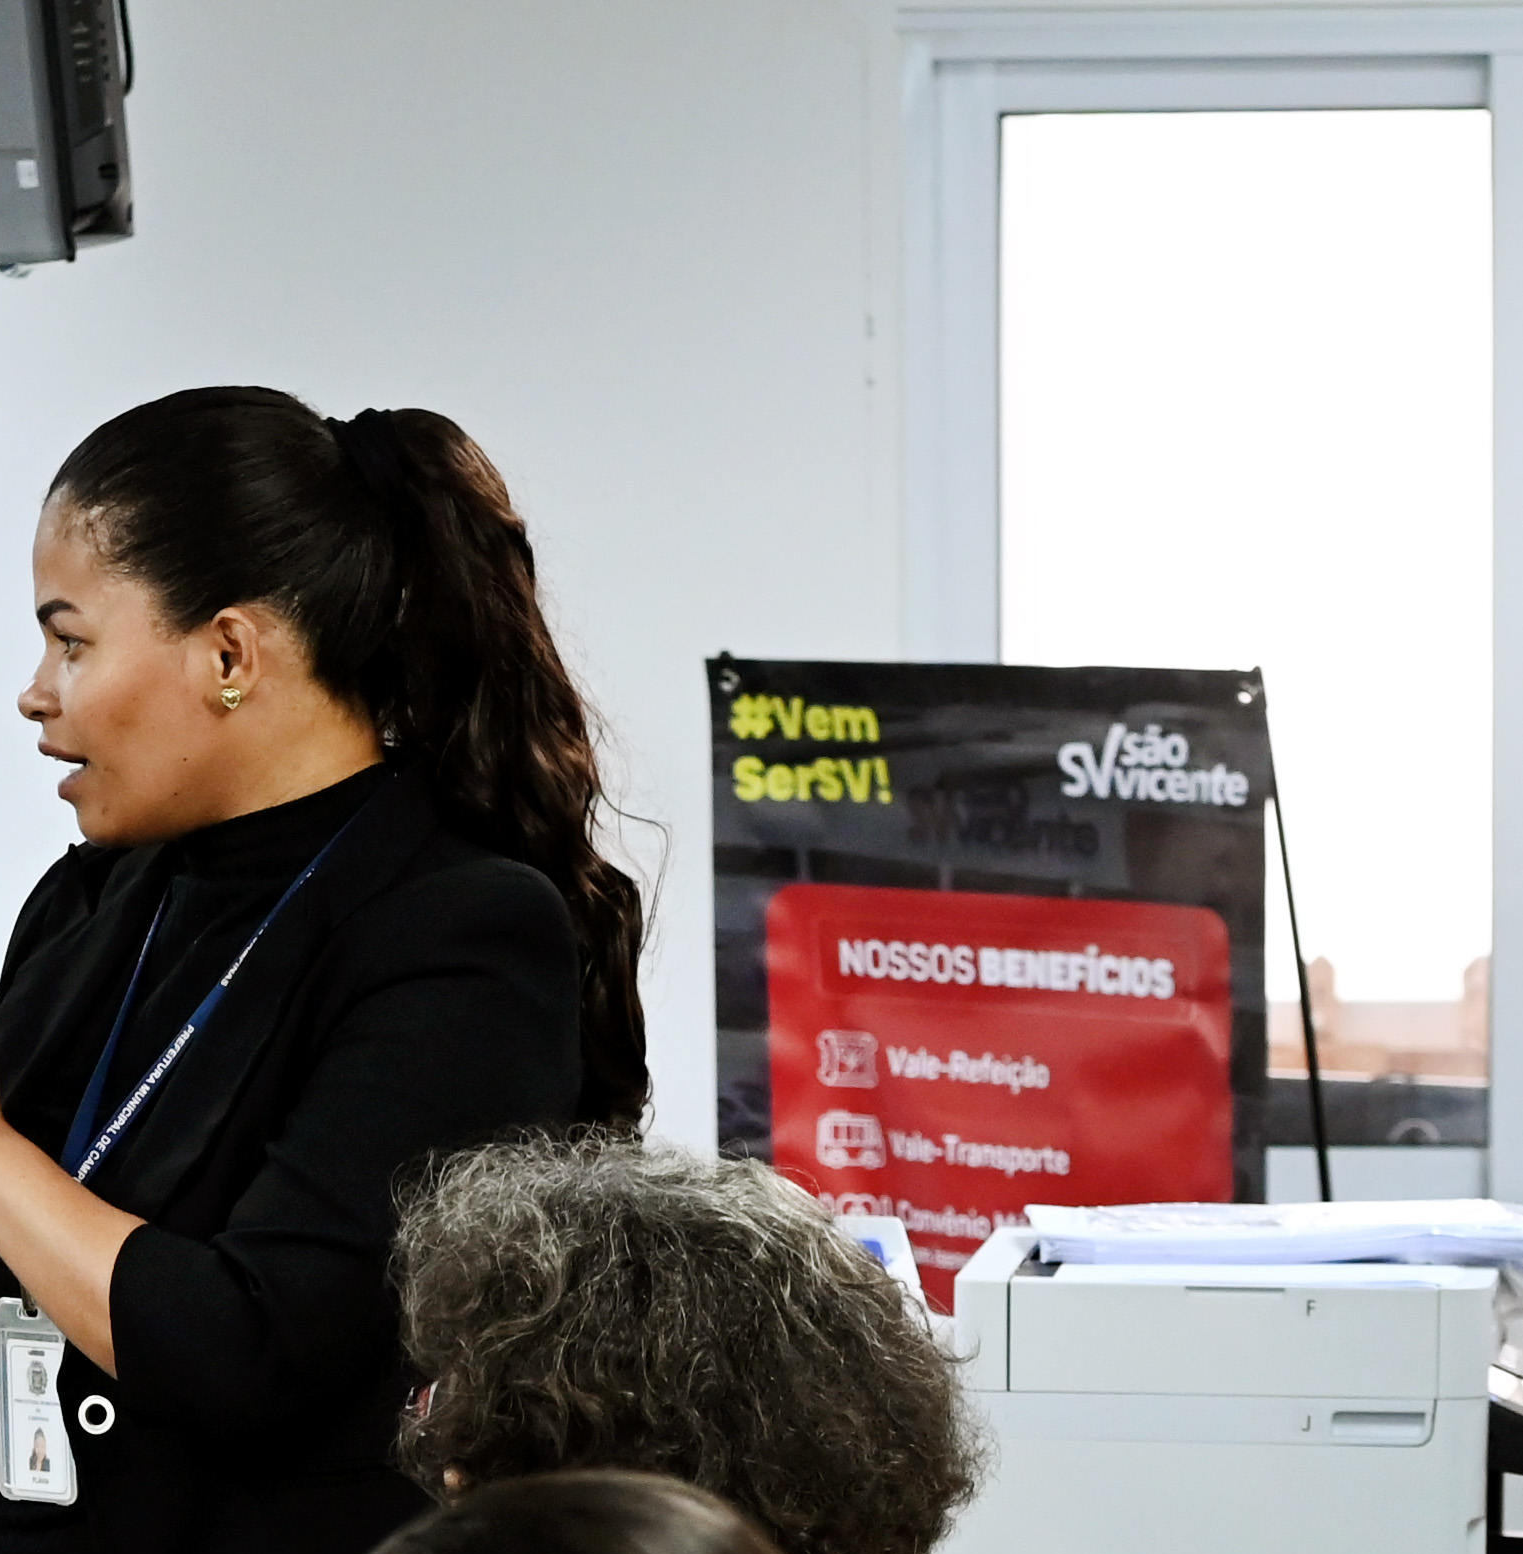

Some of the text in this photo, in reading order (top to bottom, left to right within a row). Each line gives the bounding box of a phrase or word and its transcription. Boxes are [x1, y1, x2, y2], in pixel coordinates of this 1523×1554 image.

[730, 693, 880, 742] #Vem
[1120, 723, 1189, 768] são
[733, 756, 892, 804] SerSV!
[1114, 762, 1249, 807] vicente
[838, 938, 1176, 999] NOSSOS BENEFÍCIOS
[145, 1024, 195, 1084] PREFEITURA
[885, 1045, 1051, 1095] Vale-Refeição
[106, 1083, 152, 1135] MUNICIPAL
[95, 1134, 112, 1152] DE
[888, 1130, 1071, 1178] Vale-Transporte
